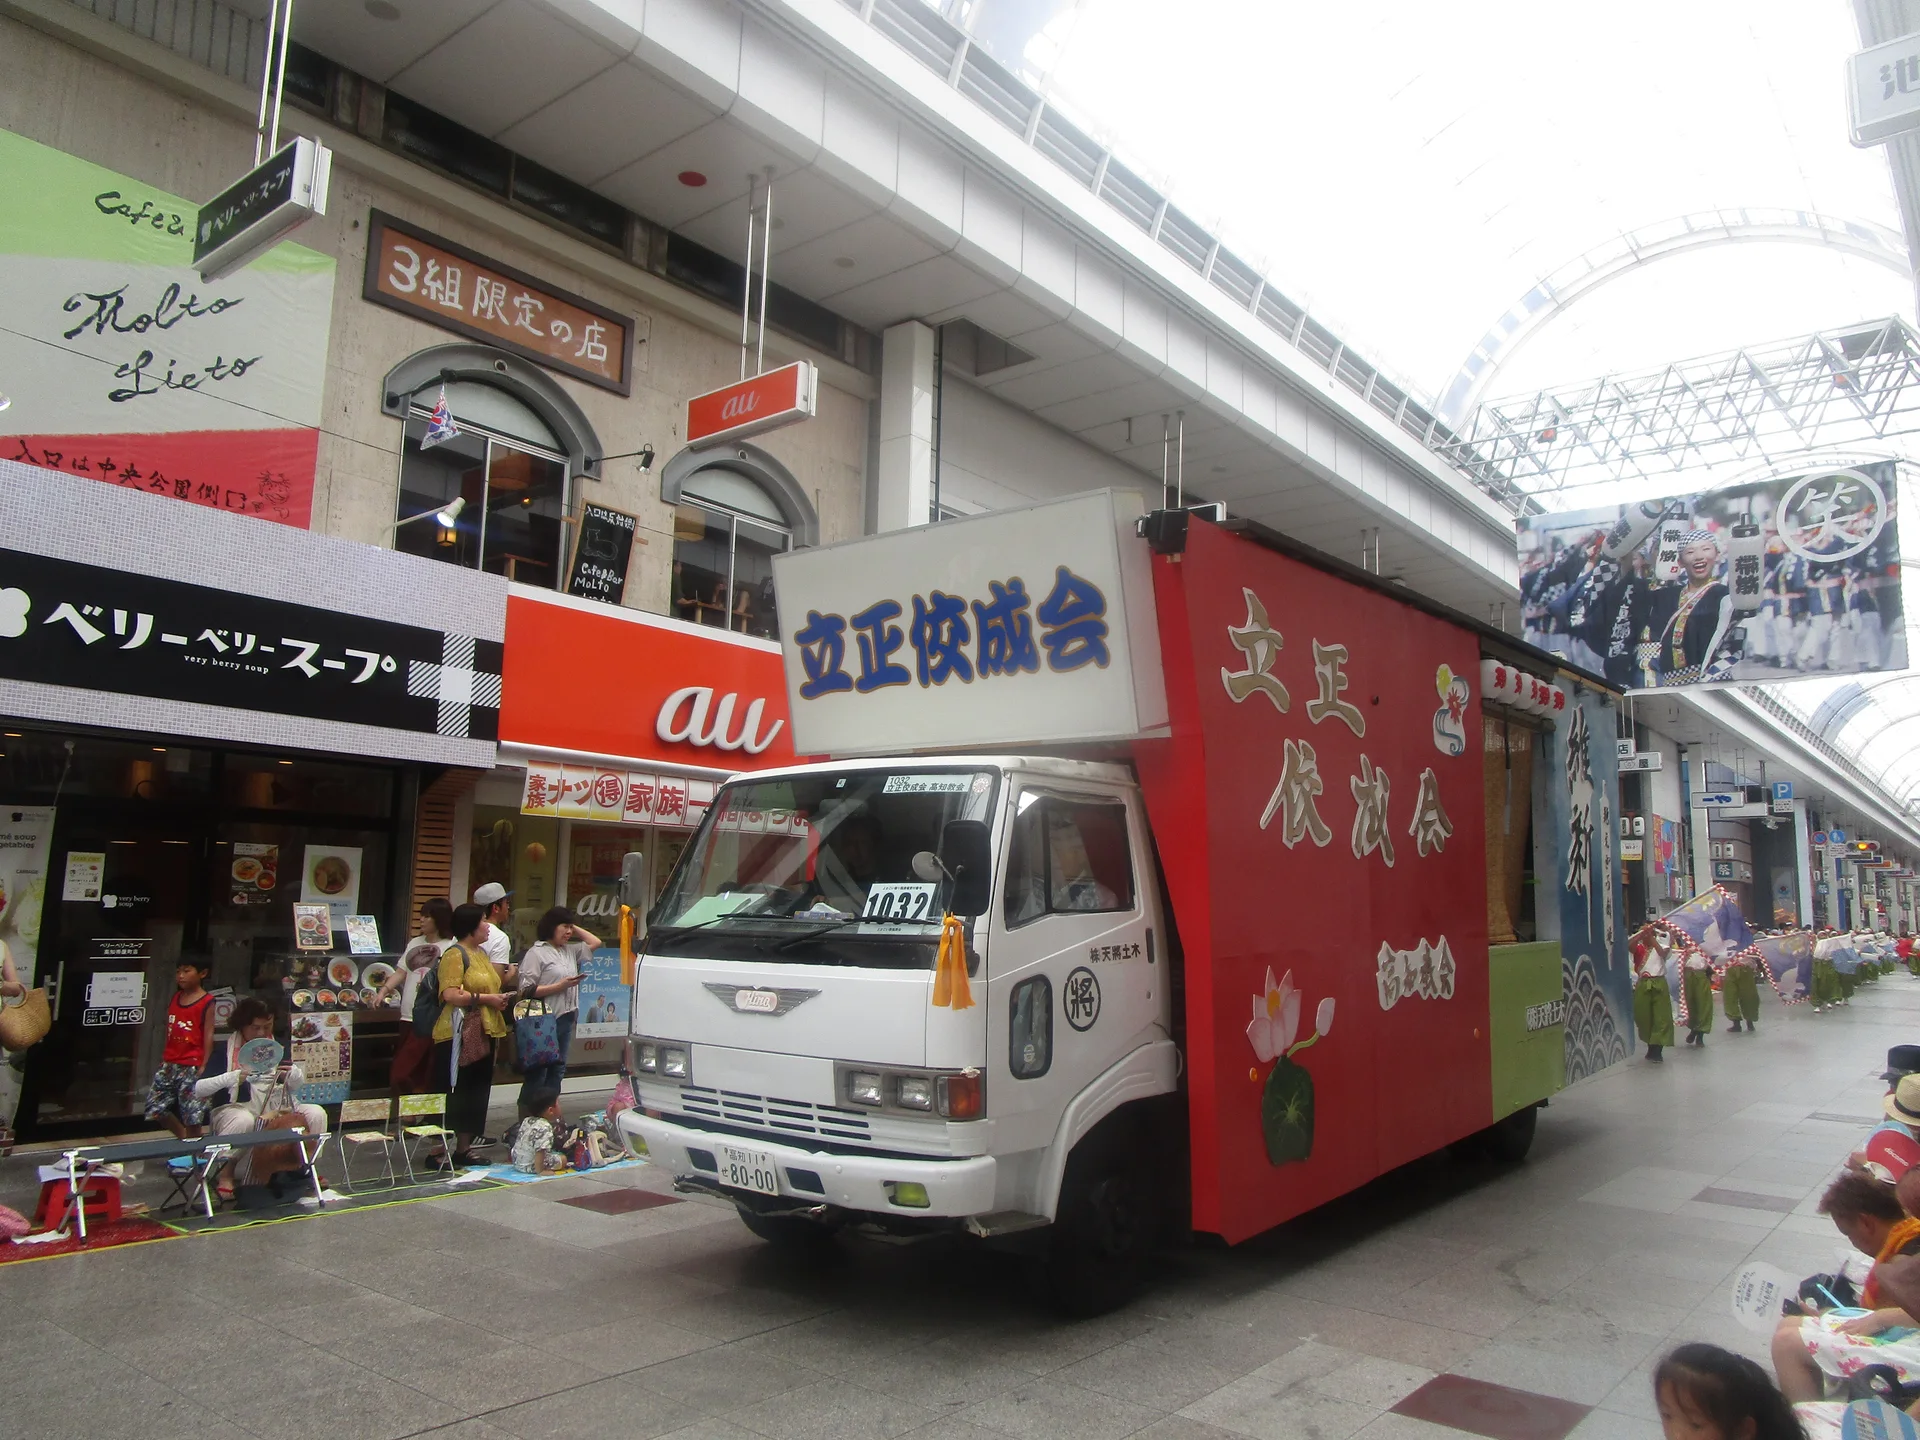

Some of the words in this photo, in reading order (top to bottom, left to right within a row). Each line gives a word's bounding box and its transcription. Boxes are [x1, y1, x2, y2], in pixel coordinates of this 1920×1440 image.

[63, 283, 244, 339] Molto
[388, 244, 609, 364] 3組限定の店
[107, 350, 263, 402] Lieto
[721, 391, 760, 420] au
[43, 602, 397, 684] ベリーベリースープ
[794, 565, 1110, 699] 立正佼成会
[184, 653, 208, 666] very
[212, 657, 241, 671] berry
[244, 662, 270, 676] soup
[1221, 587, 1366, 738] 立正
[656, 686, 784, 754] au
[885, 782, 927, 793] 立正佼成会
[889, 776, 911, 786] 1032
[1777, 784, 1788, 797] P
[134, 895, 150, 903] berry
[577, 894, 620, 917] au
[867, 892, 929, 924] 1032
[744, 992, 771, 1008] Hino
[584, 1040, 606, 1051] au
[721, 1166, 729, 1178] せ
[730, 1162, 775, 1192] 80-00
